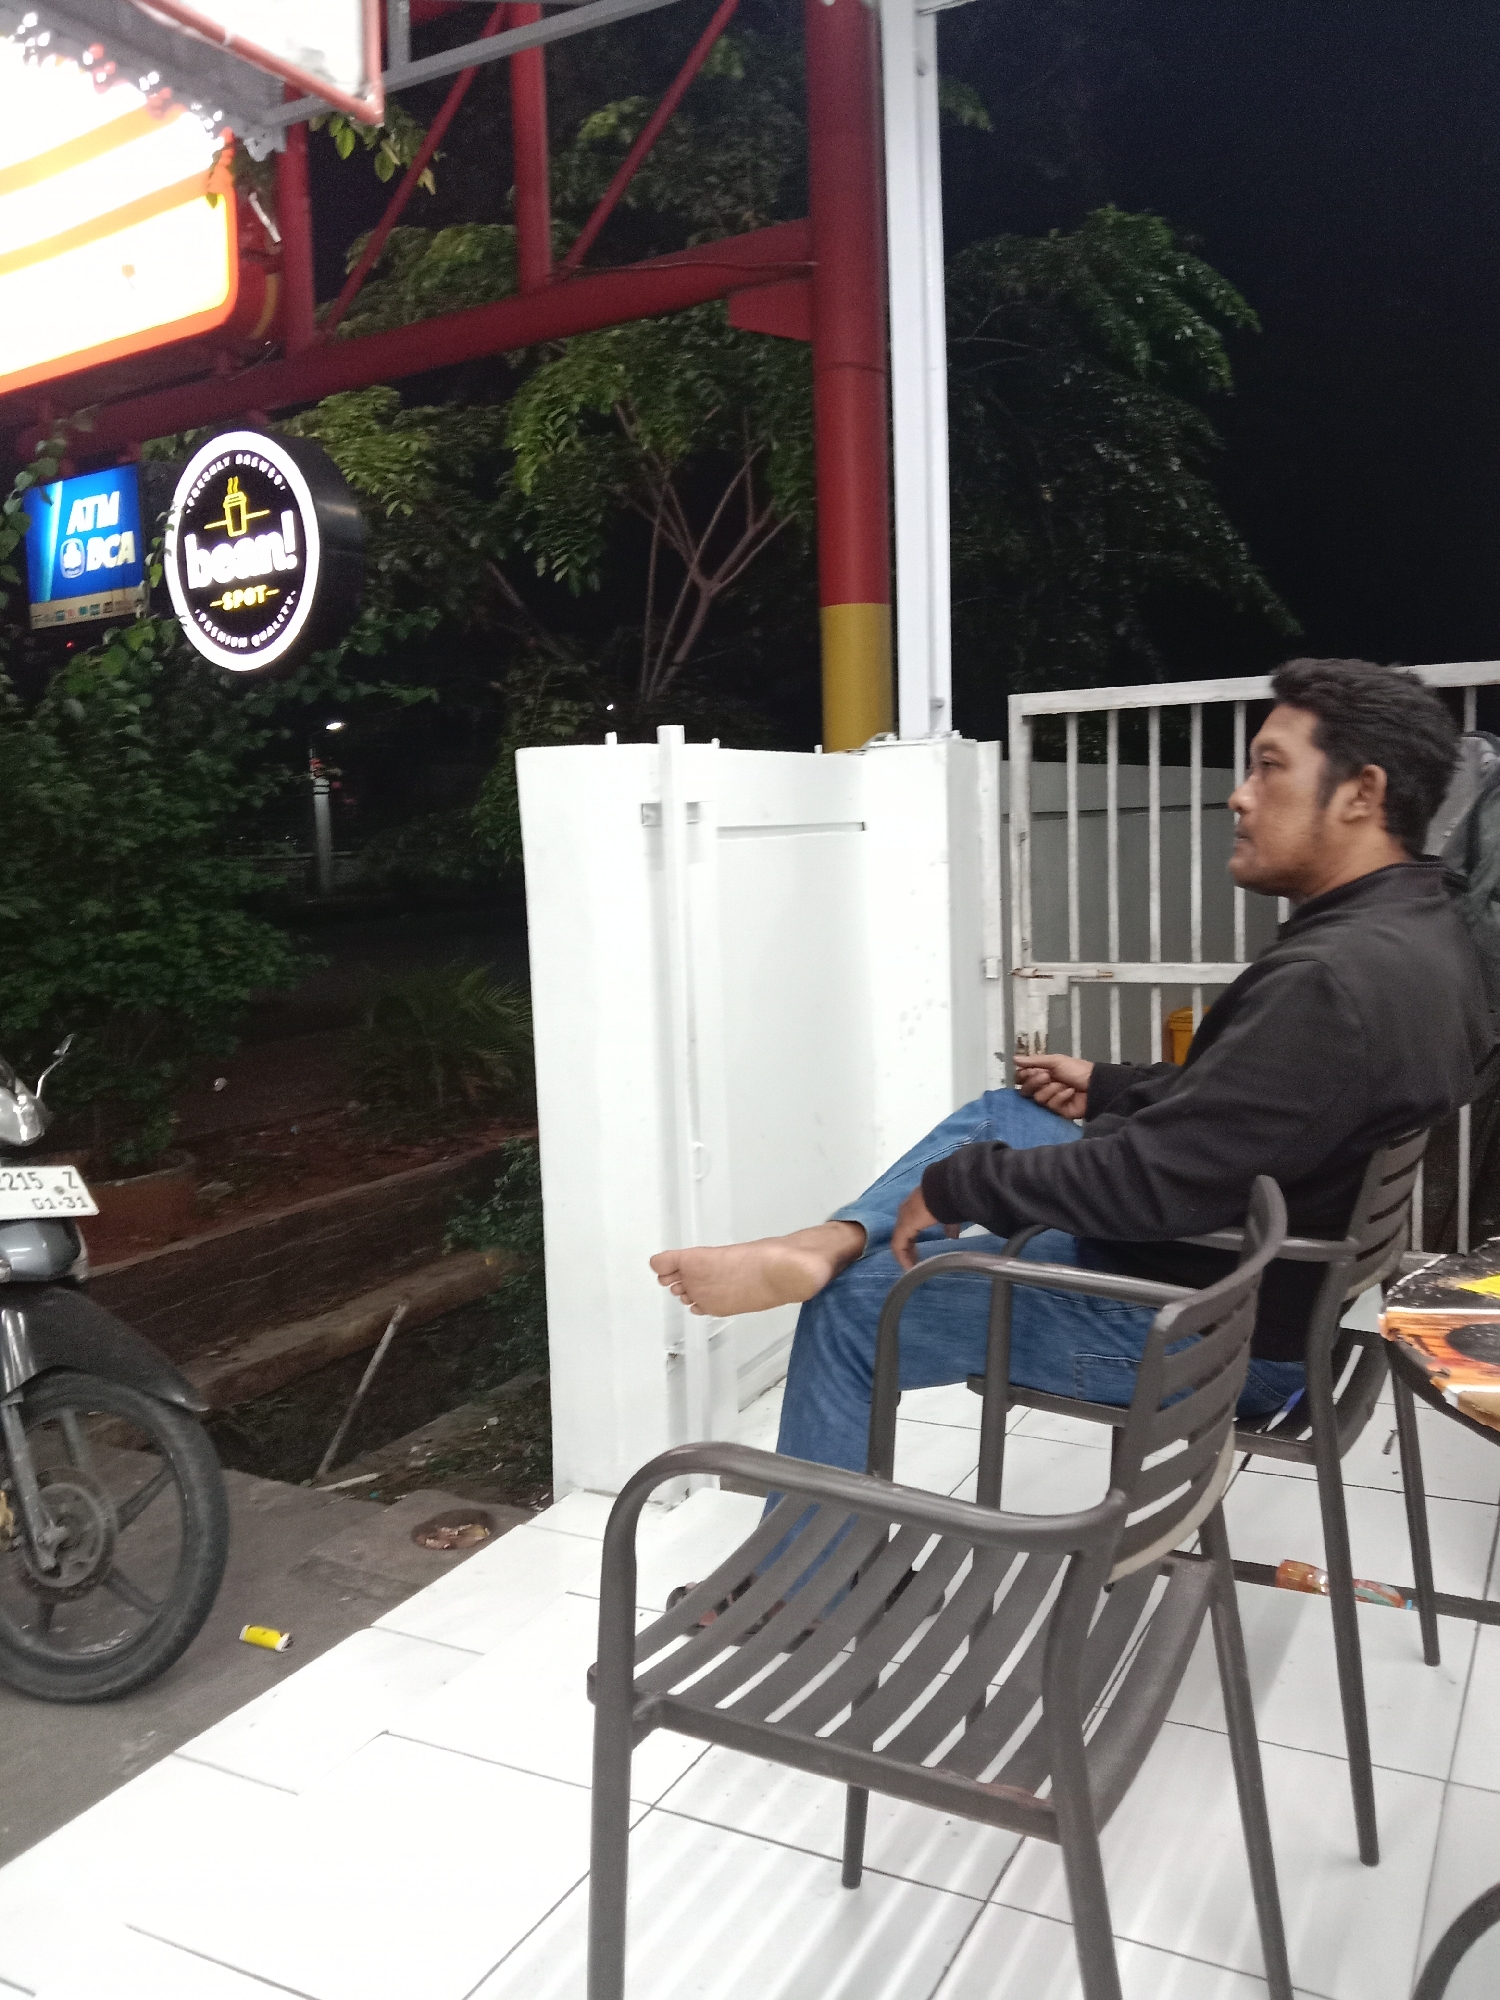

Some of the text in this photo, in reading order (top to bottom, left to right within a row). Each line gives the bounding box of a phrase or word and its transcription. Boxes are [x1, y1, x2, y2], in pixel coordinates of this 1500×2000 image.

[66, 491, 120, 535] ATM
[86, 531, 136, 571] BCA
[184, 510, 298, 589] bean!
[222, 584, 267, 611] SPOT
